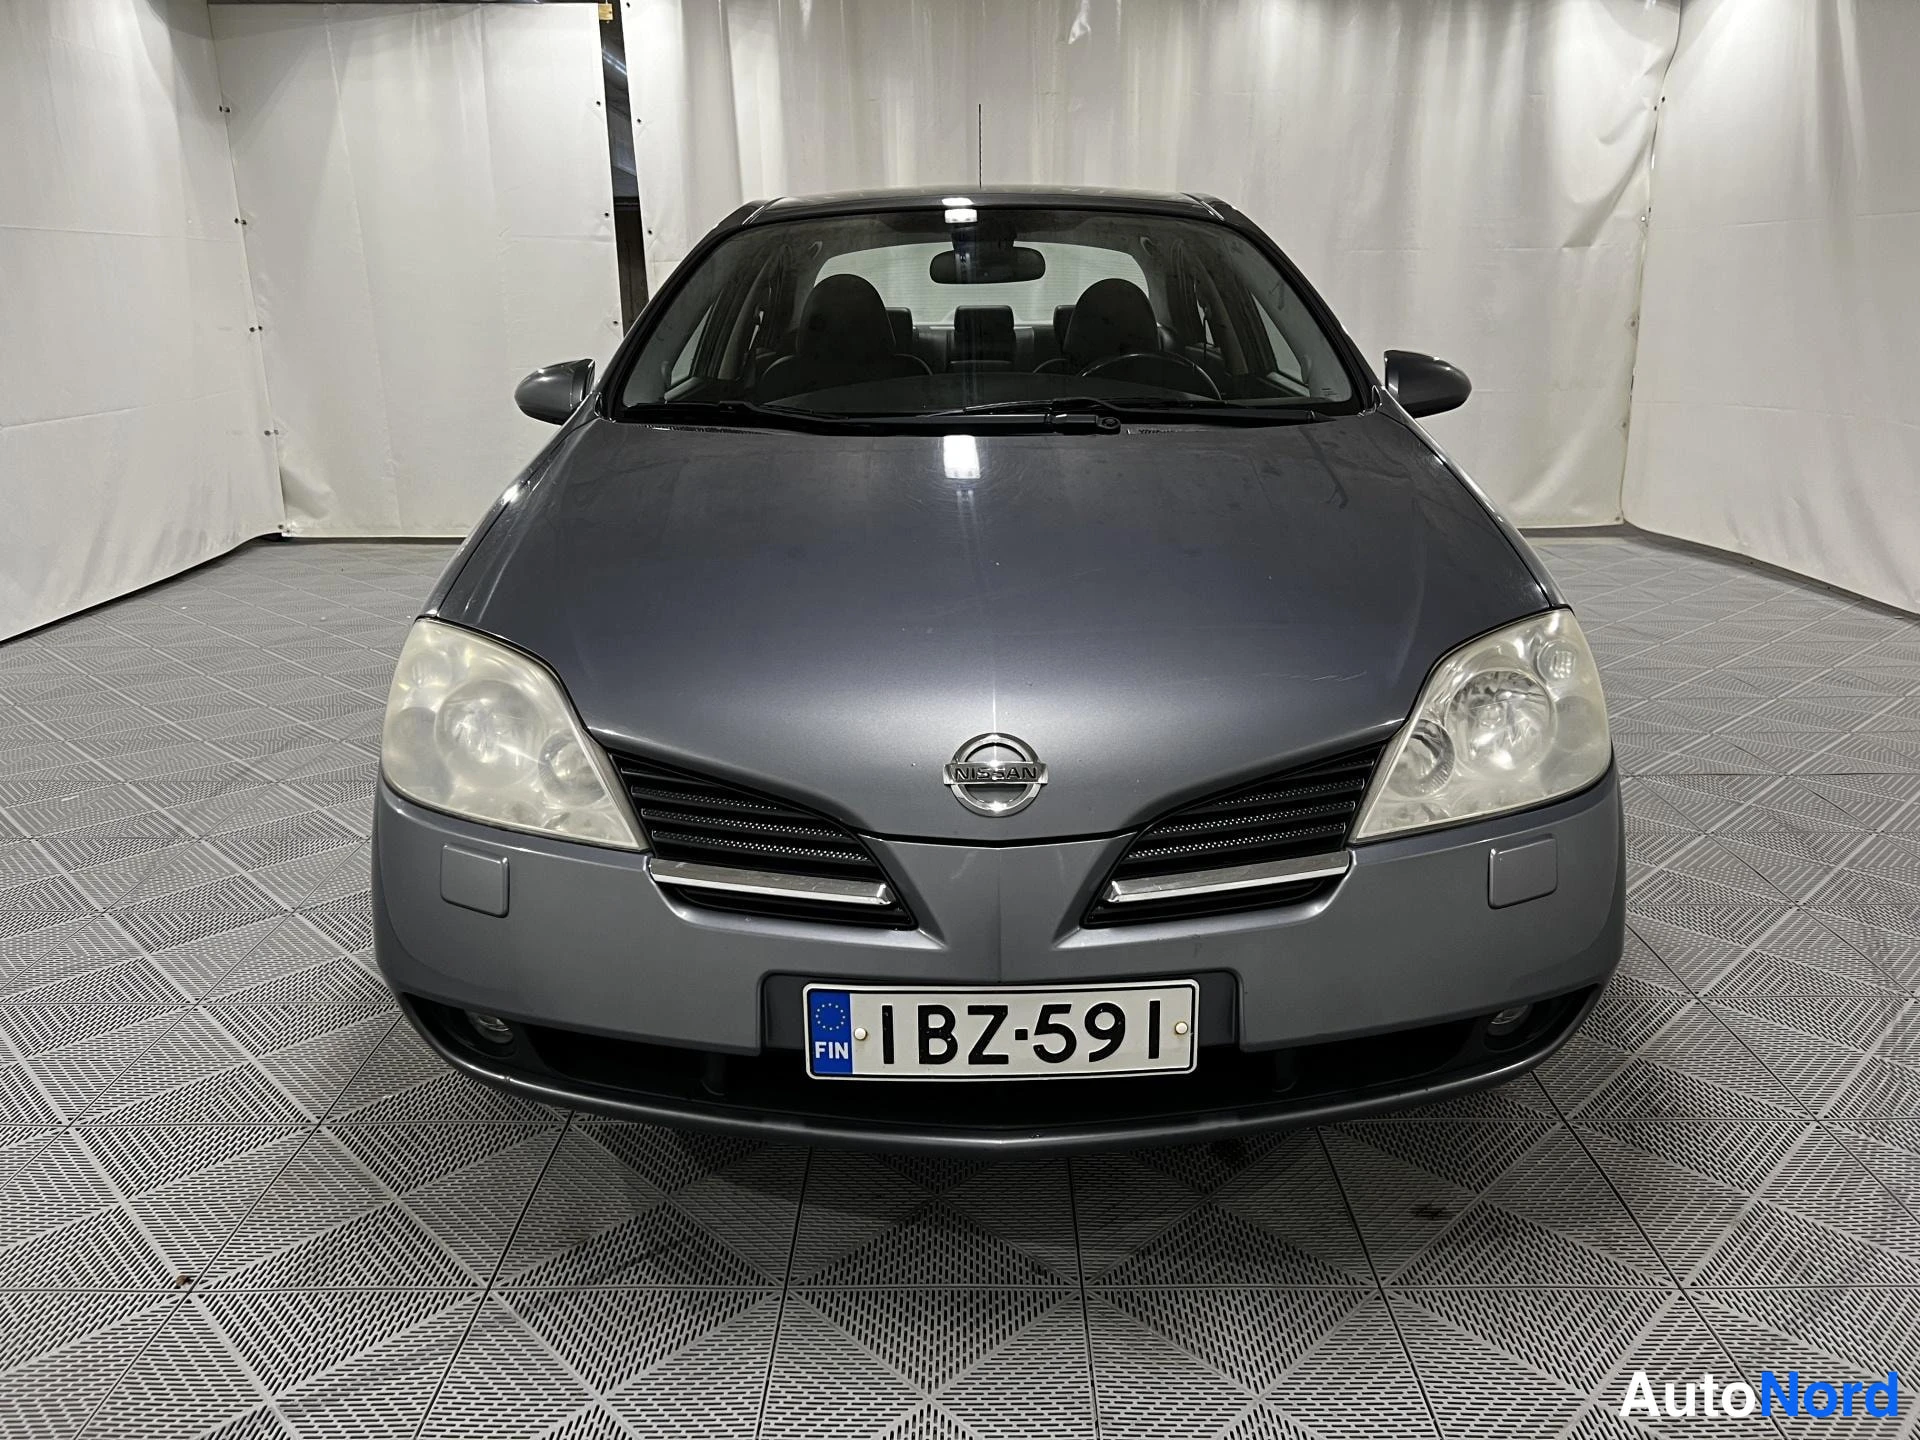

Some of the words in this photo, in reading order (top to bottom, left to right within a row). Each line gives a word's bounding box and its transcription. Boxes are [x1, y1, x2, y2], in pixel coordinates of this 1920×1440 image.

[954, 767, 1037, 780] NISSAN
[881, 999, 1161, 1065] IBZ-591
[814, 1040, 849, 1060] FIN
